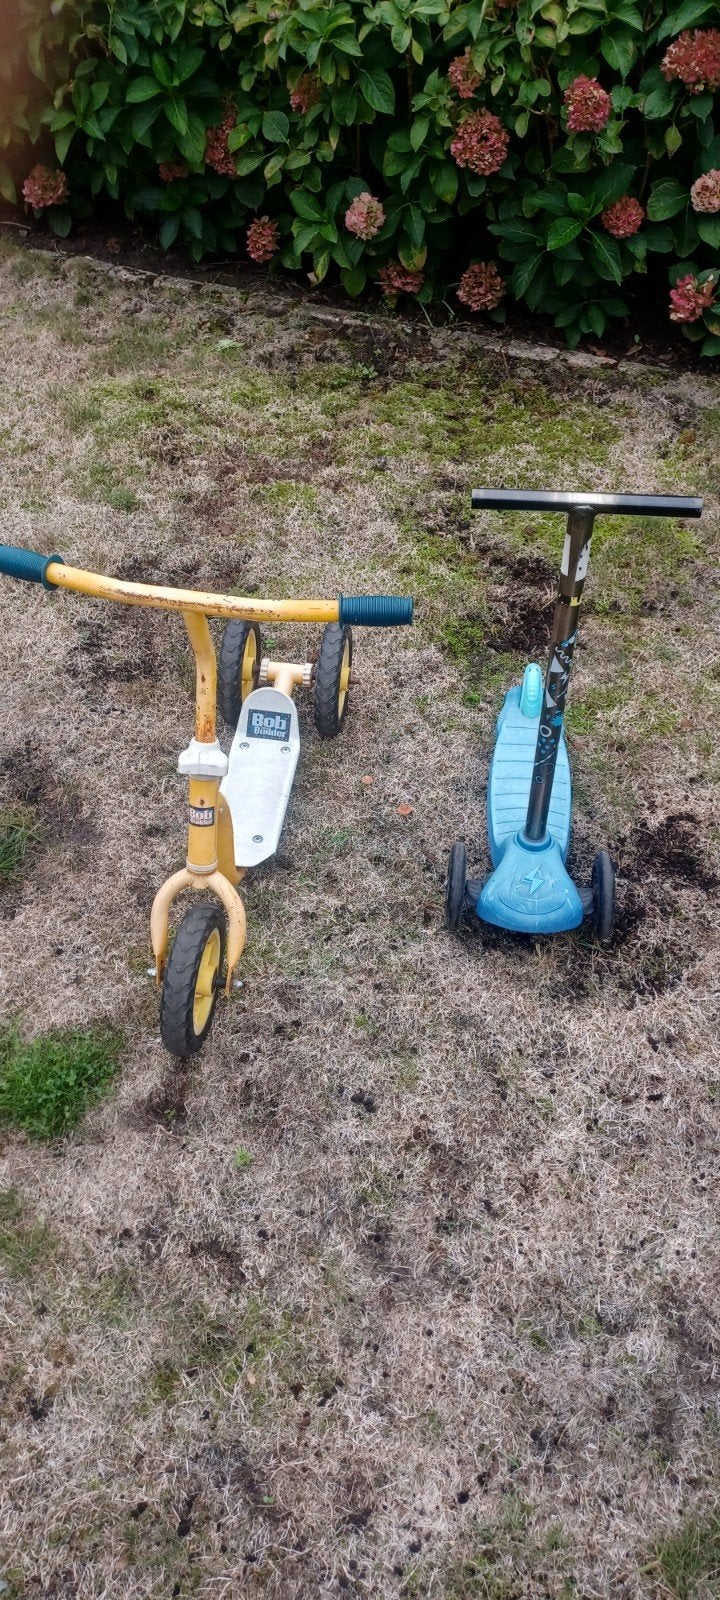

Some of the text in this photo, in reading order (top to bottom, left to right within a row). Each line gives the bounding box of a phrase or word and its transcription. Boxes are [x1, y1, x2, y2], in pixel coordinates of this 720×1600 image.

[252, 713, 287, 730] Bob
[254, 726, 287, 737] Builder
[190, 808, 213, 820] Bob
